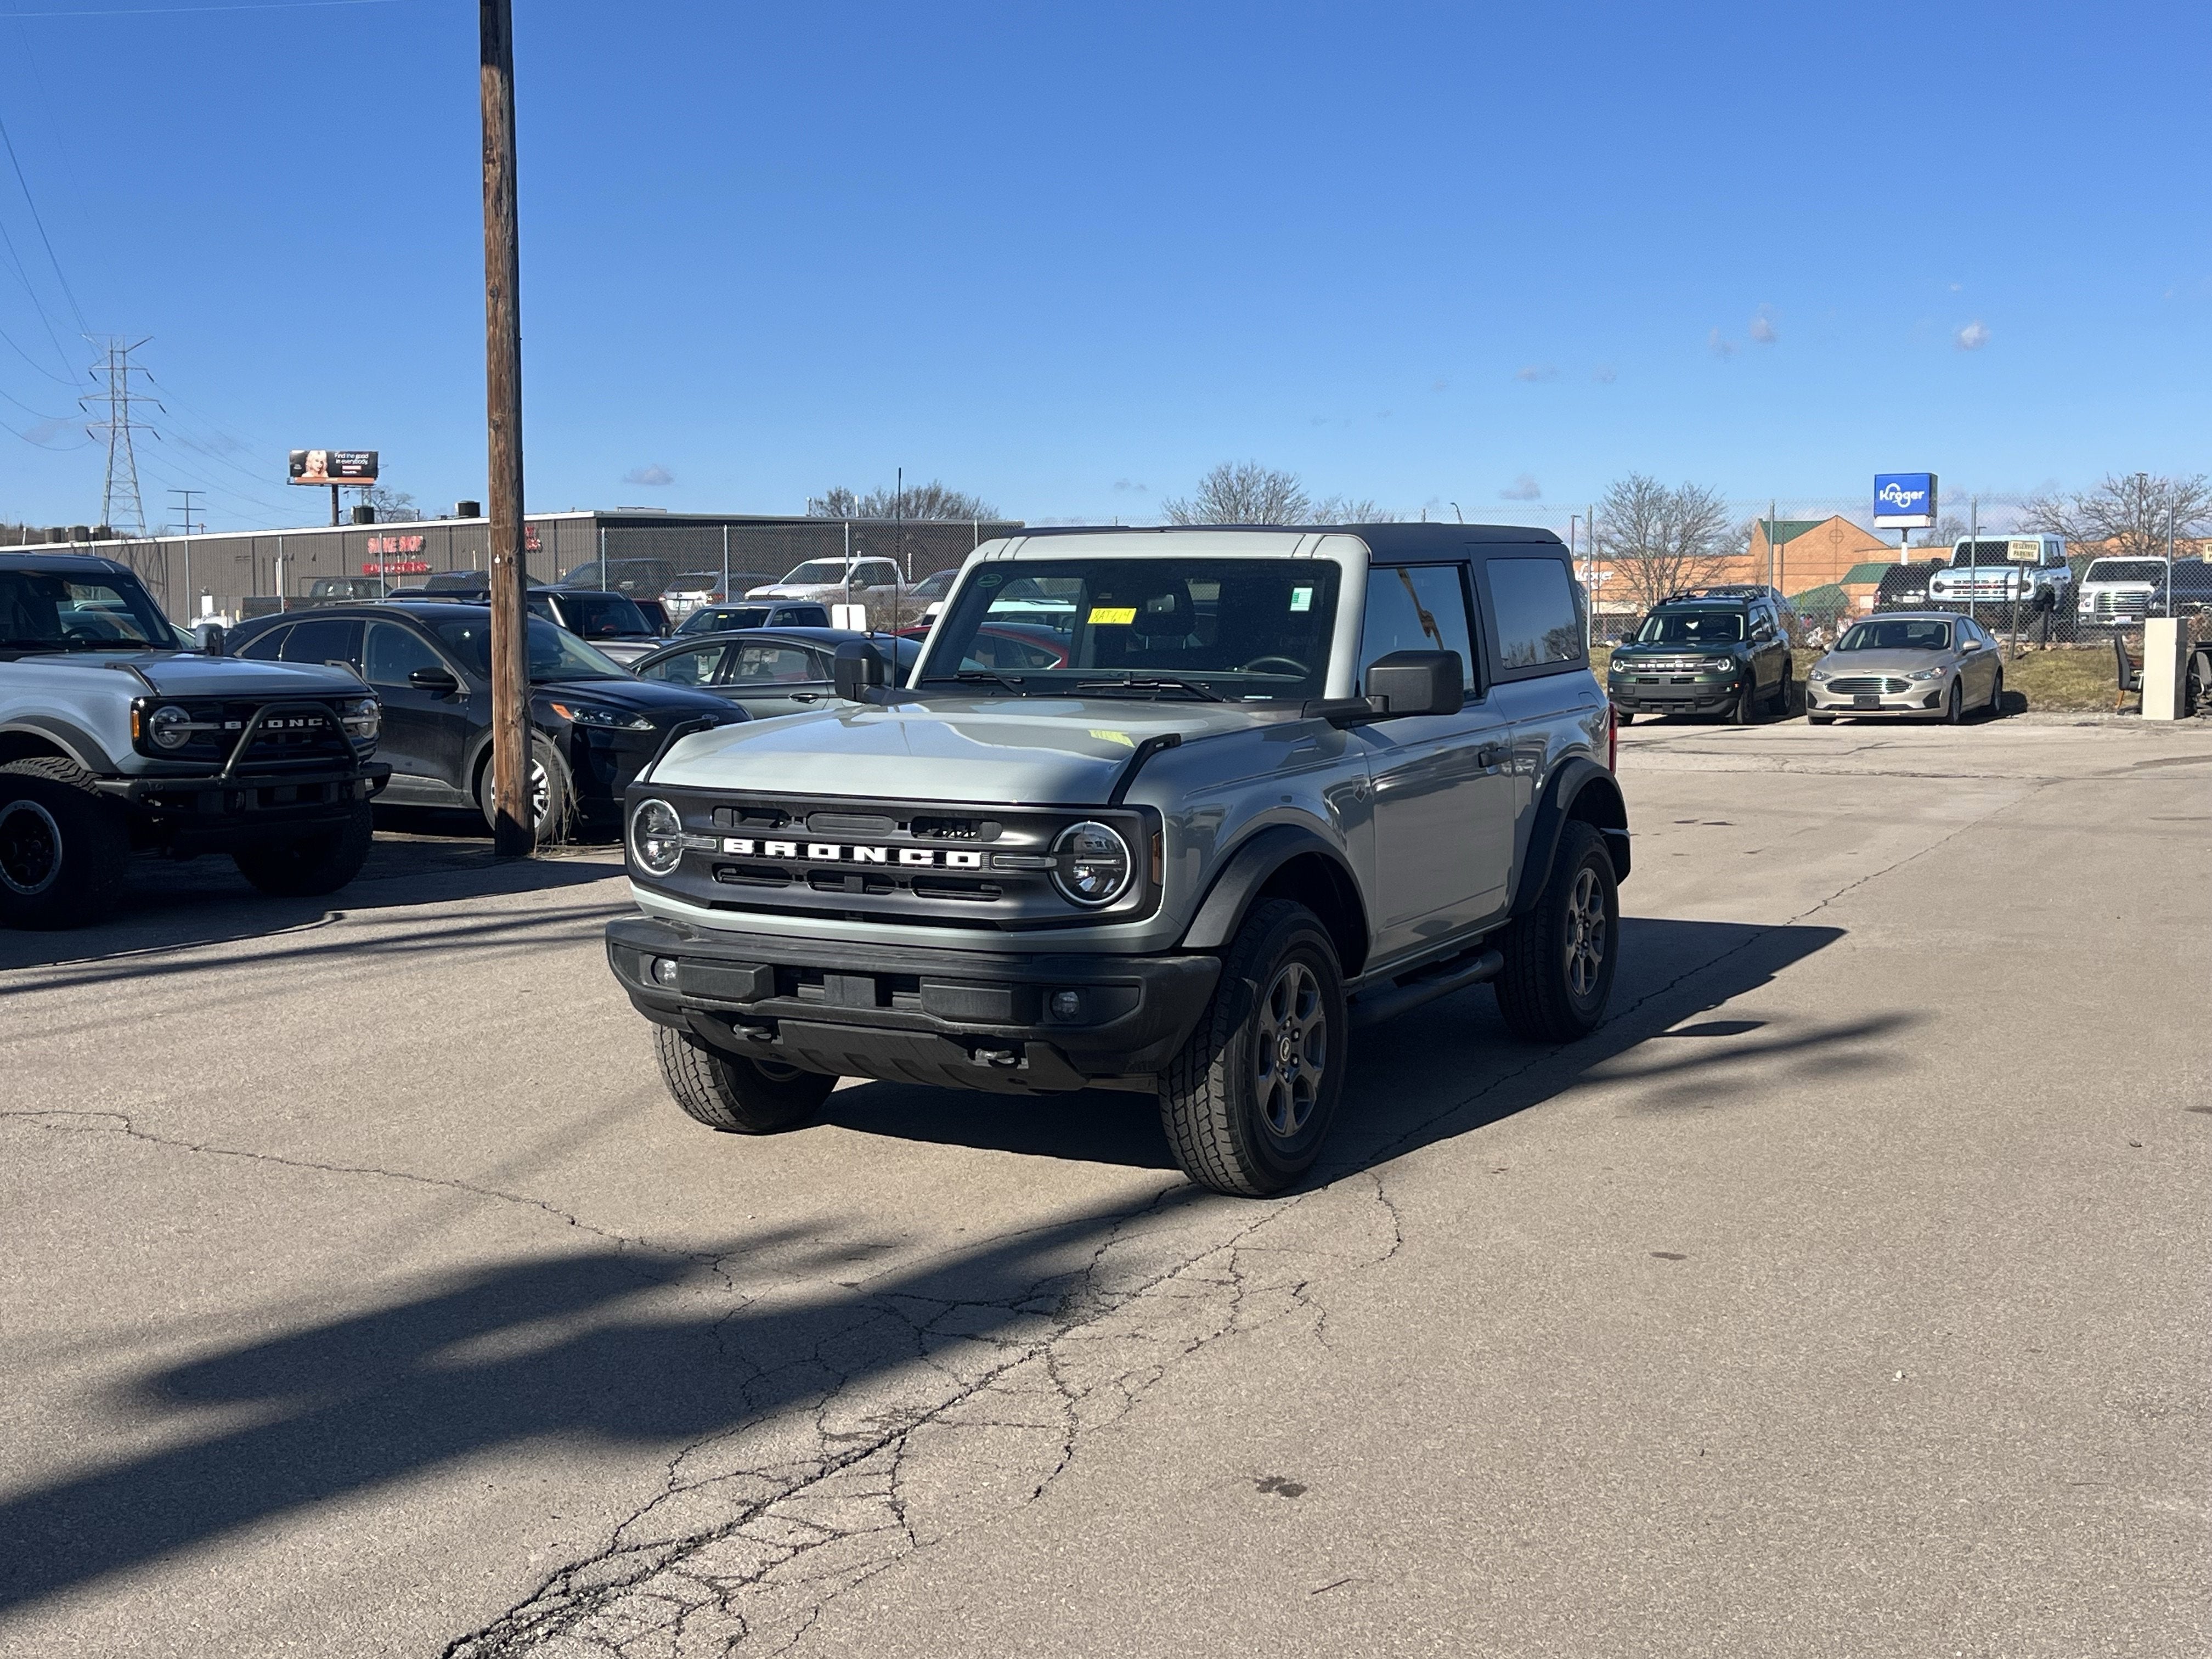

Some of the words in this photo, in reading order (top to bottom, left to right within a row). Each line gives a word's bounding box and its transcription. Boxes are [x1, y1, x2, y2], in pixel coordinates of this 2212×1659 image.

[1879, 483, 1925, 508] Kroger
[1574, 562, 1615, 590] Kroger
[224, 717, 341, 729] BONC
[723, 838, 981, 871] BRONCO
